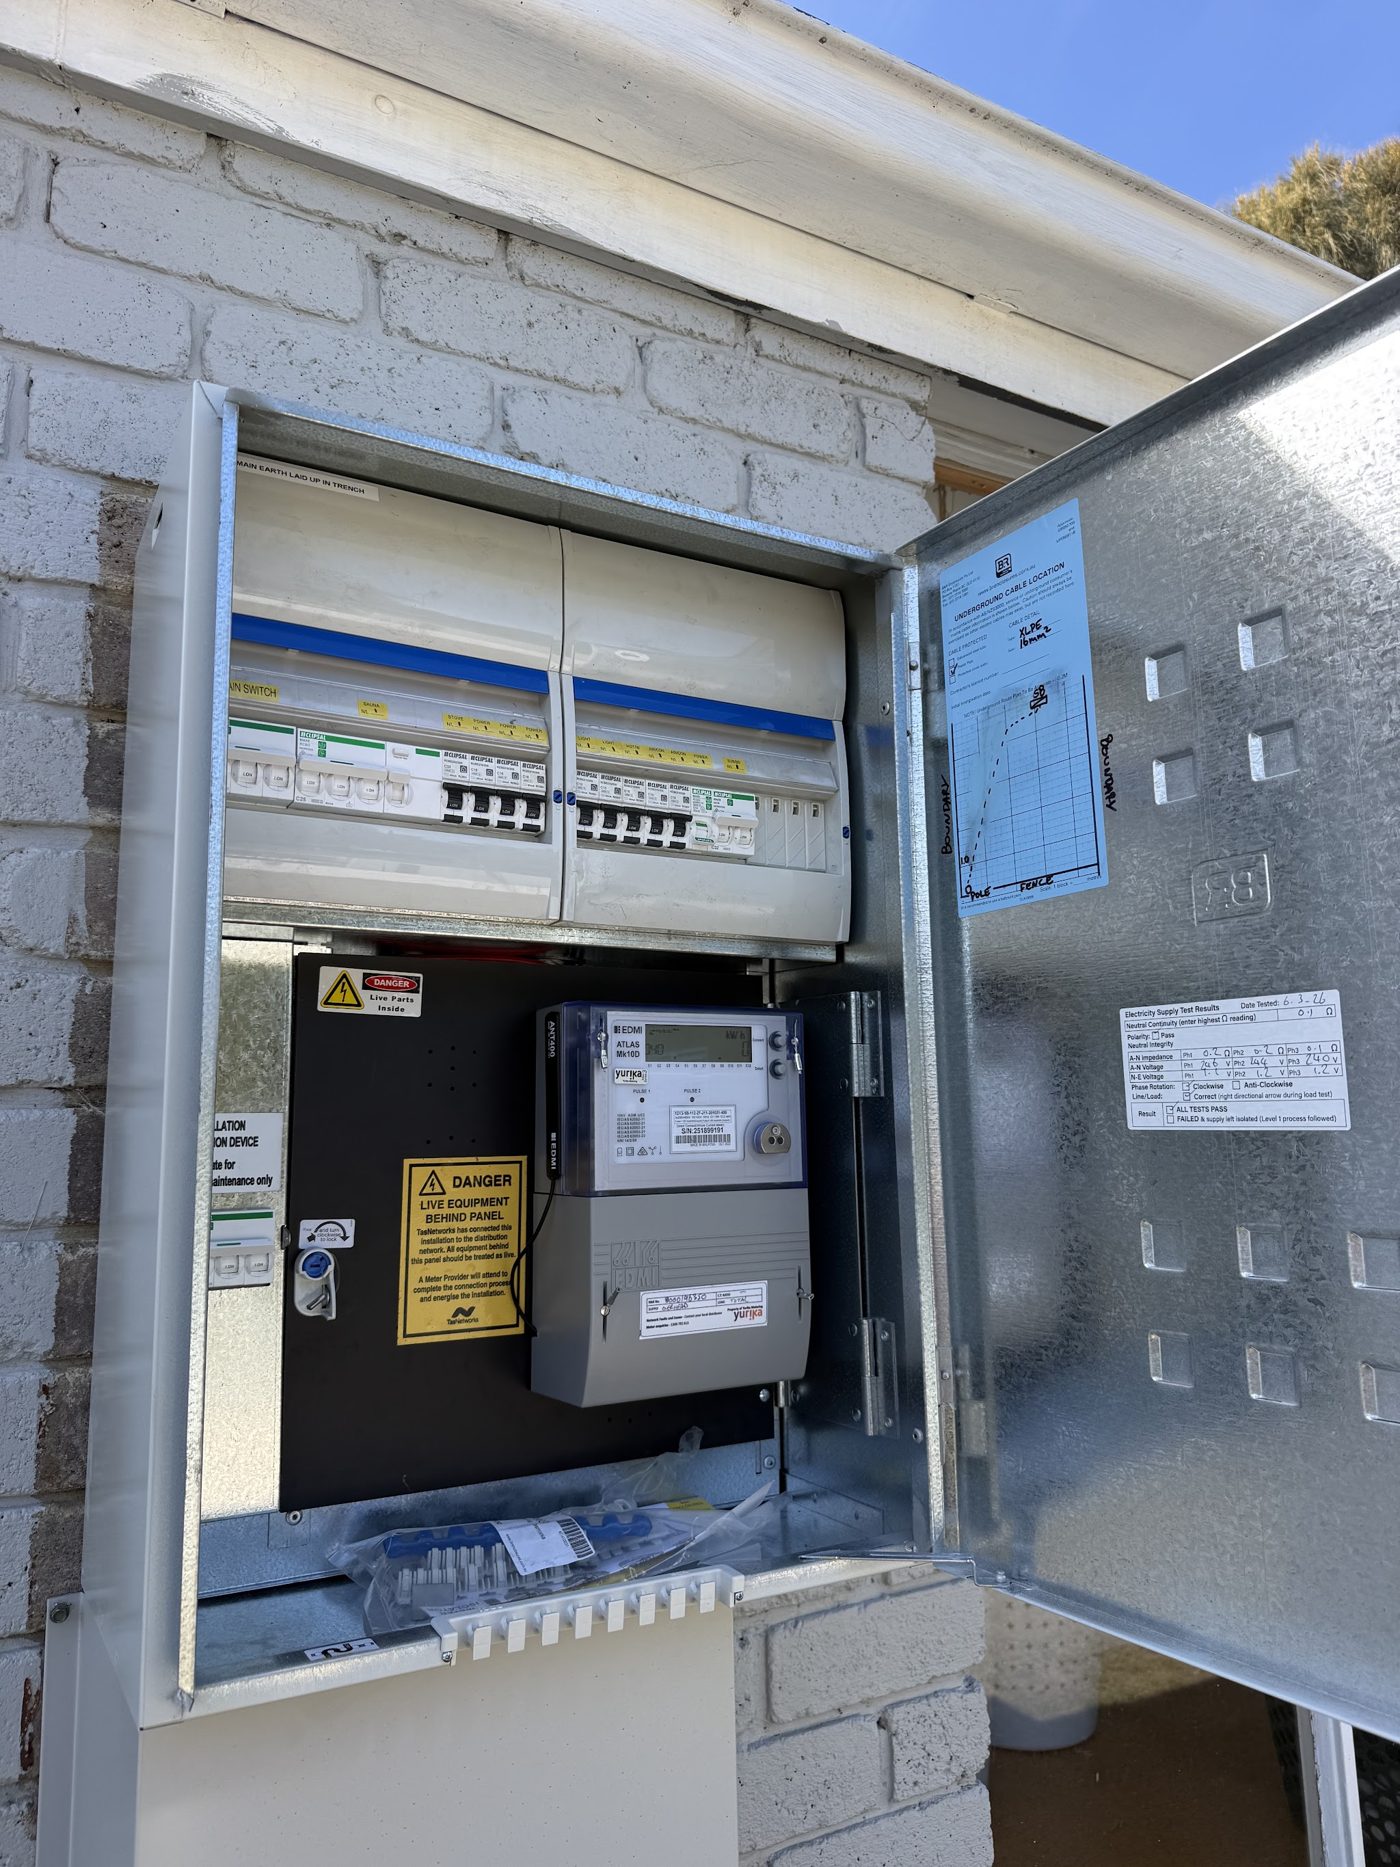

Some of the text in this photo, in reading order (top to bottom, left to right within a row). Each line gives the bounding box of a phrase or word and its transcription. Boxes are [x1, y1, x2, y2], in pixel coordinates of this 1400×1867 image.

[237, 460, 365, 494] MAIN EARTH LAID UP IN TRENCH
[954, 592, 1004, 622] UNDERGROUND
[1004, 580, 1028, 597] CABLE
[1028, 561, 1065, 586] LOCATION
[1008, 617, 1023, 629] CABLE
[1019, 618, 1043, 638] XLPE
[948, 645, 961, 657] CABLE
[243, 684, 277, 698] SWITCH
[448, 714, 464, 722] STOVE
[473, 718, 490, 726] POWER
[448, 752, 468, 760] CLIPSAL
[475, 756, 494, 764] CLIPSAL
[501, 759, 520, 767] CLIPSAL
[526, 763, 545, 771] CLIPSAL
[581, 771, 598, 779] CLIPSAL
[1100, 734, 1117, 812] BOUNDARY
[674, 784, 690, 792] CLIPSAL
[940, 775, 953, 855] BOUNDARY
[1019, 875, 1054, 893] FENCE
[970, 886, 992, 902] POLE
[374, 979, 410, 988] DANGER
[370, 994, 388, 1002] Live
[1240, 1000, 1280, 1009] Date Tested:
[1125, 1004, 1220, 1018] Electricity Supply Test Results
[1148, 1019, 1178, 1028] Continuity
[1178, 1018, 1196, 1026] (enter
[1198, 1016, 1220, 1025] highest
[1221, 1014, 1228, 1022] Ω
[1229, 1013, 1256, 1022] reading)
[622, 1026, 643, 1034] EDMI
[1127, 1033, 1150, 1041] Polarity:
[1150, 1041, 1174, 1049] Integrity
[616, 1050, 640, 1058] Mk10D
[1141, 1053, 1174, 1062] Impedance
[1306, 1053, 1330, 1066] 240
[1142, 1064, 1164, 1072] Voltage
[615, 1070, 642, 1081] yurika
[1192, 1082, 1224, 1090] Clockwise
[1244, 1080, 1293, 1089] Anti-Clockwise
[1218, 1092, 1233, 1100] (right
[1234, 1092, 1264, 1100] directional
[1282, 1091, 1302, 1100] during
[1304, 1090, 1317, 1098] load
[1318, 1090, 1332, 1098] test)
[1260, 1114, 1278, 1123] (Level
[1308, 1114, 1337, 1122] followed)
[230, 1136, 259, 1147] DEVICE
[224, 1158, 236, 1170] for
[256, 1174, 274, 1188] only
[452, 1174, 512, 1188] DANGER
[420, 1196, 510, 1210] LIVE EQUIPMENT
[426, 1210, 504, 1224] BEHIND PANEL
[417, 1226, 456, 1236] TasNetworks
[456, 1226, 468, 1234] has
[468, 1224, 500, 1233] connected
[420, 1236, 455, 1245] installation
[463, 1235, 474, 1243] the
[474, 1234, 508, 1242] distribution
[446, 1246, 455, 1254] All
[456, 1244, 488, 1254] equipment
[488, 1242, 510, 1250] behind
[424, 1256, 442, 1266] panel
[442, 1254, 464, 1263] should
[464, 1254, 473, 1262] be
[473, 1252, 495, 1260] treated
[418, 1270, 509, 1284] A Meter Provider will attend to
[413, 1285, 442, 1294] complete
[454, 1282, 488, 1290] connection
[420, 1294, 432, 1302] and
[432, 1292, 460, 1302] energise
[471, 1289, 506, 1298] installation.
[446, 1317, 479, 1325] TasNetworks
[733, 1308, 764, 1322] yurika
